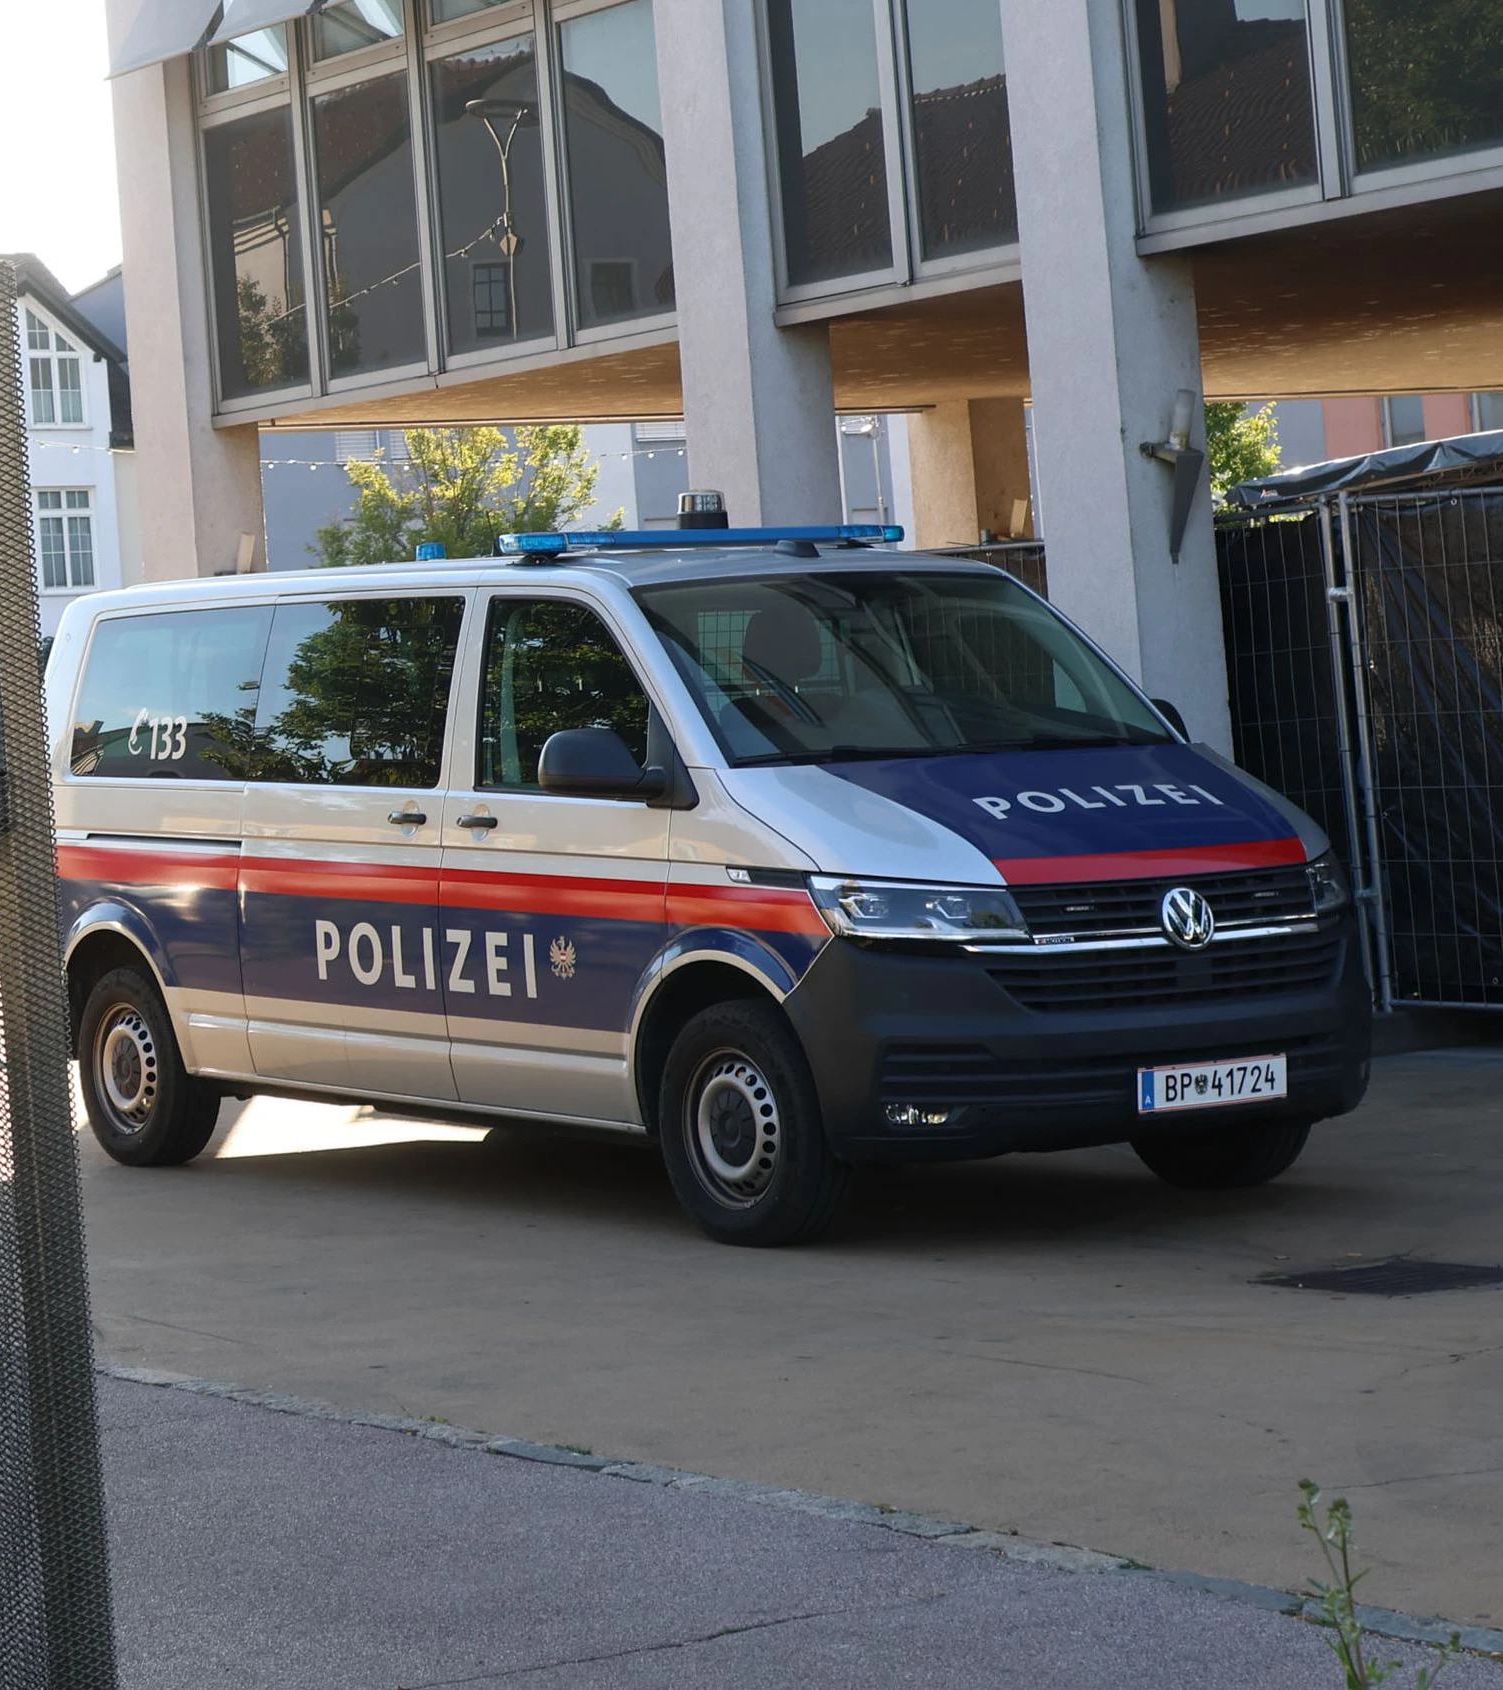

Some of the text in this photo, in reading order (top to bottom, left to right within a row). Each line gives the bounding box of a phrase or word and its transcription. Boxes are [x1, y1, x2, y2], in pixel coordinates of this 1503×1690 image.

[149, 716, 187, 760] 133
[972, 784, 1224, 820] POLIZEI
[315, 919, 538, 998] POLIZEI
[1164, 1072, 1192, 1102] BP
[1211, 1063, 1276, 1097] 41724
